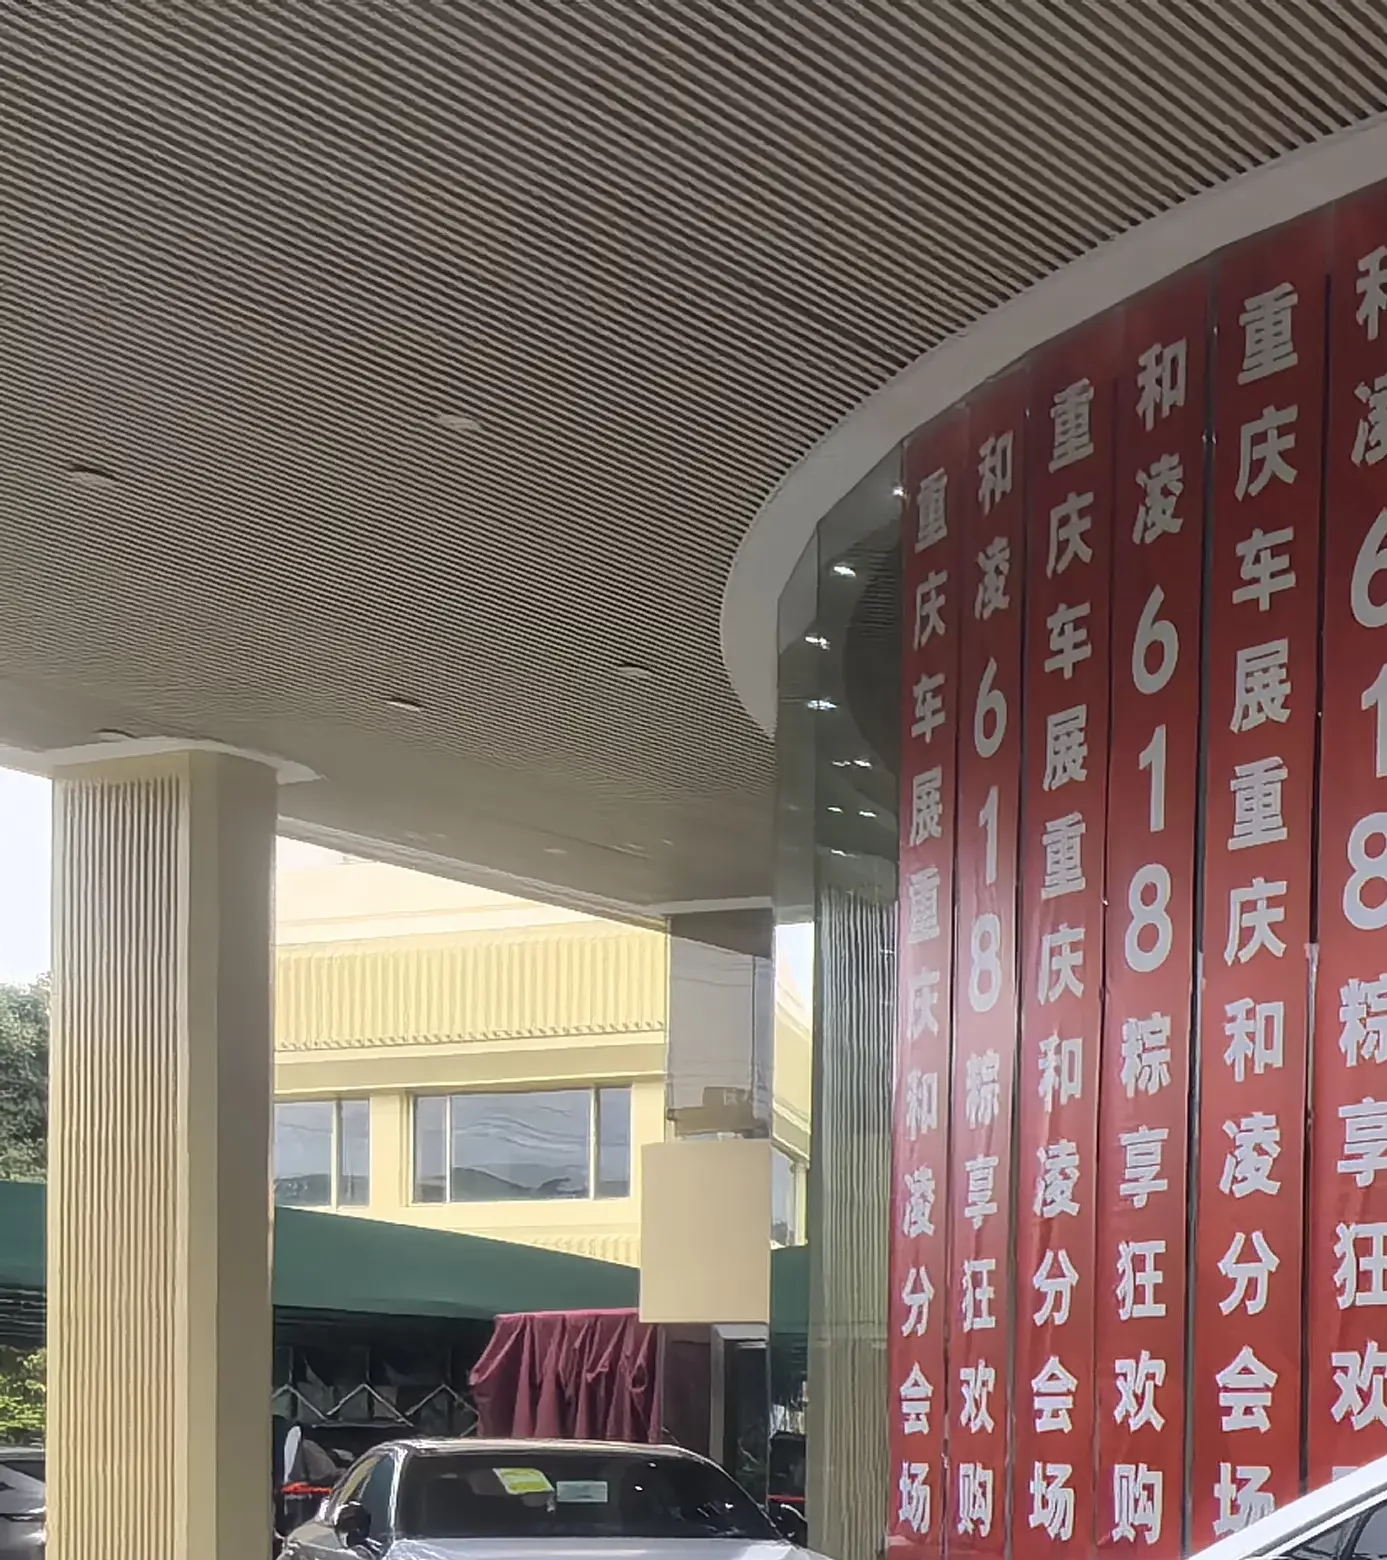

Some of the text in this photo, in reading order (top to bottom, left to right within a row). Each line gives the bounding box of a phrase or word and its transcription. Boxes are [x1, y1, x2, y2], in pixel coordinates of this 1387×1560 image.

[1028, 378, 1095, 1540] 重庆车展重庆和凌分会场
[1112, 337, 1188, 1544] 和凌618粽享狂欢购
